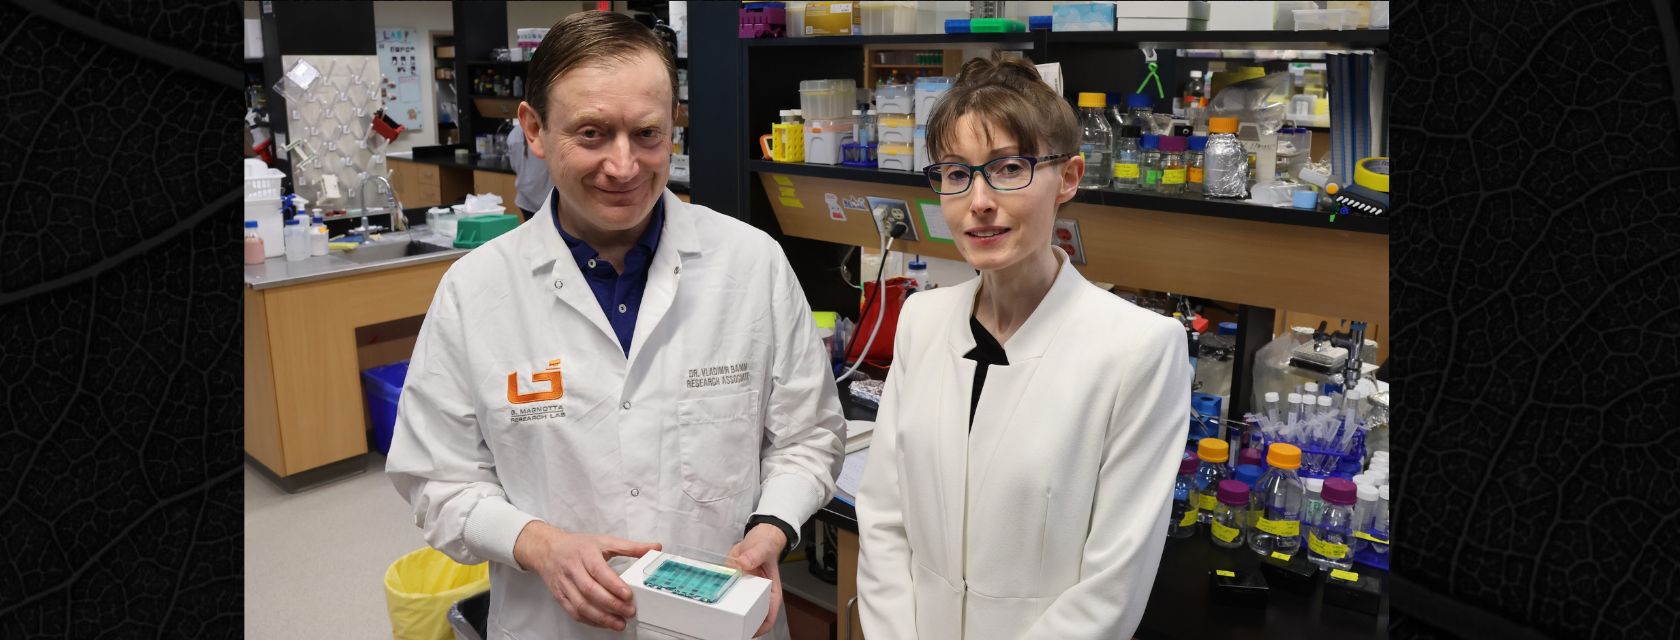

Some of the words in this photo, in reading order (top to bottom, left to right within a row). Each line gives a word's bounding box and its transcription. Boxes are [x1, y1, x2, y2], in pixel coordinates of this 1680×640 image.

[689, 369, 700, 378] DR.
[701, 366, 730, 377] VLADIMIR
[687, 377, 720, 388] RESEARCH
[722, 372, 750, 385] ASSOCIATE
[511, 415, 547, 423] RESEARCH
